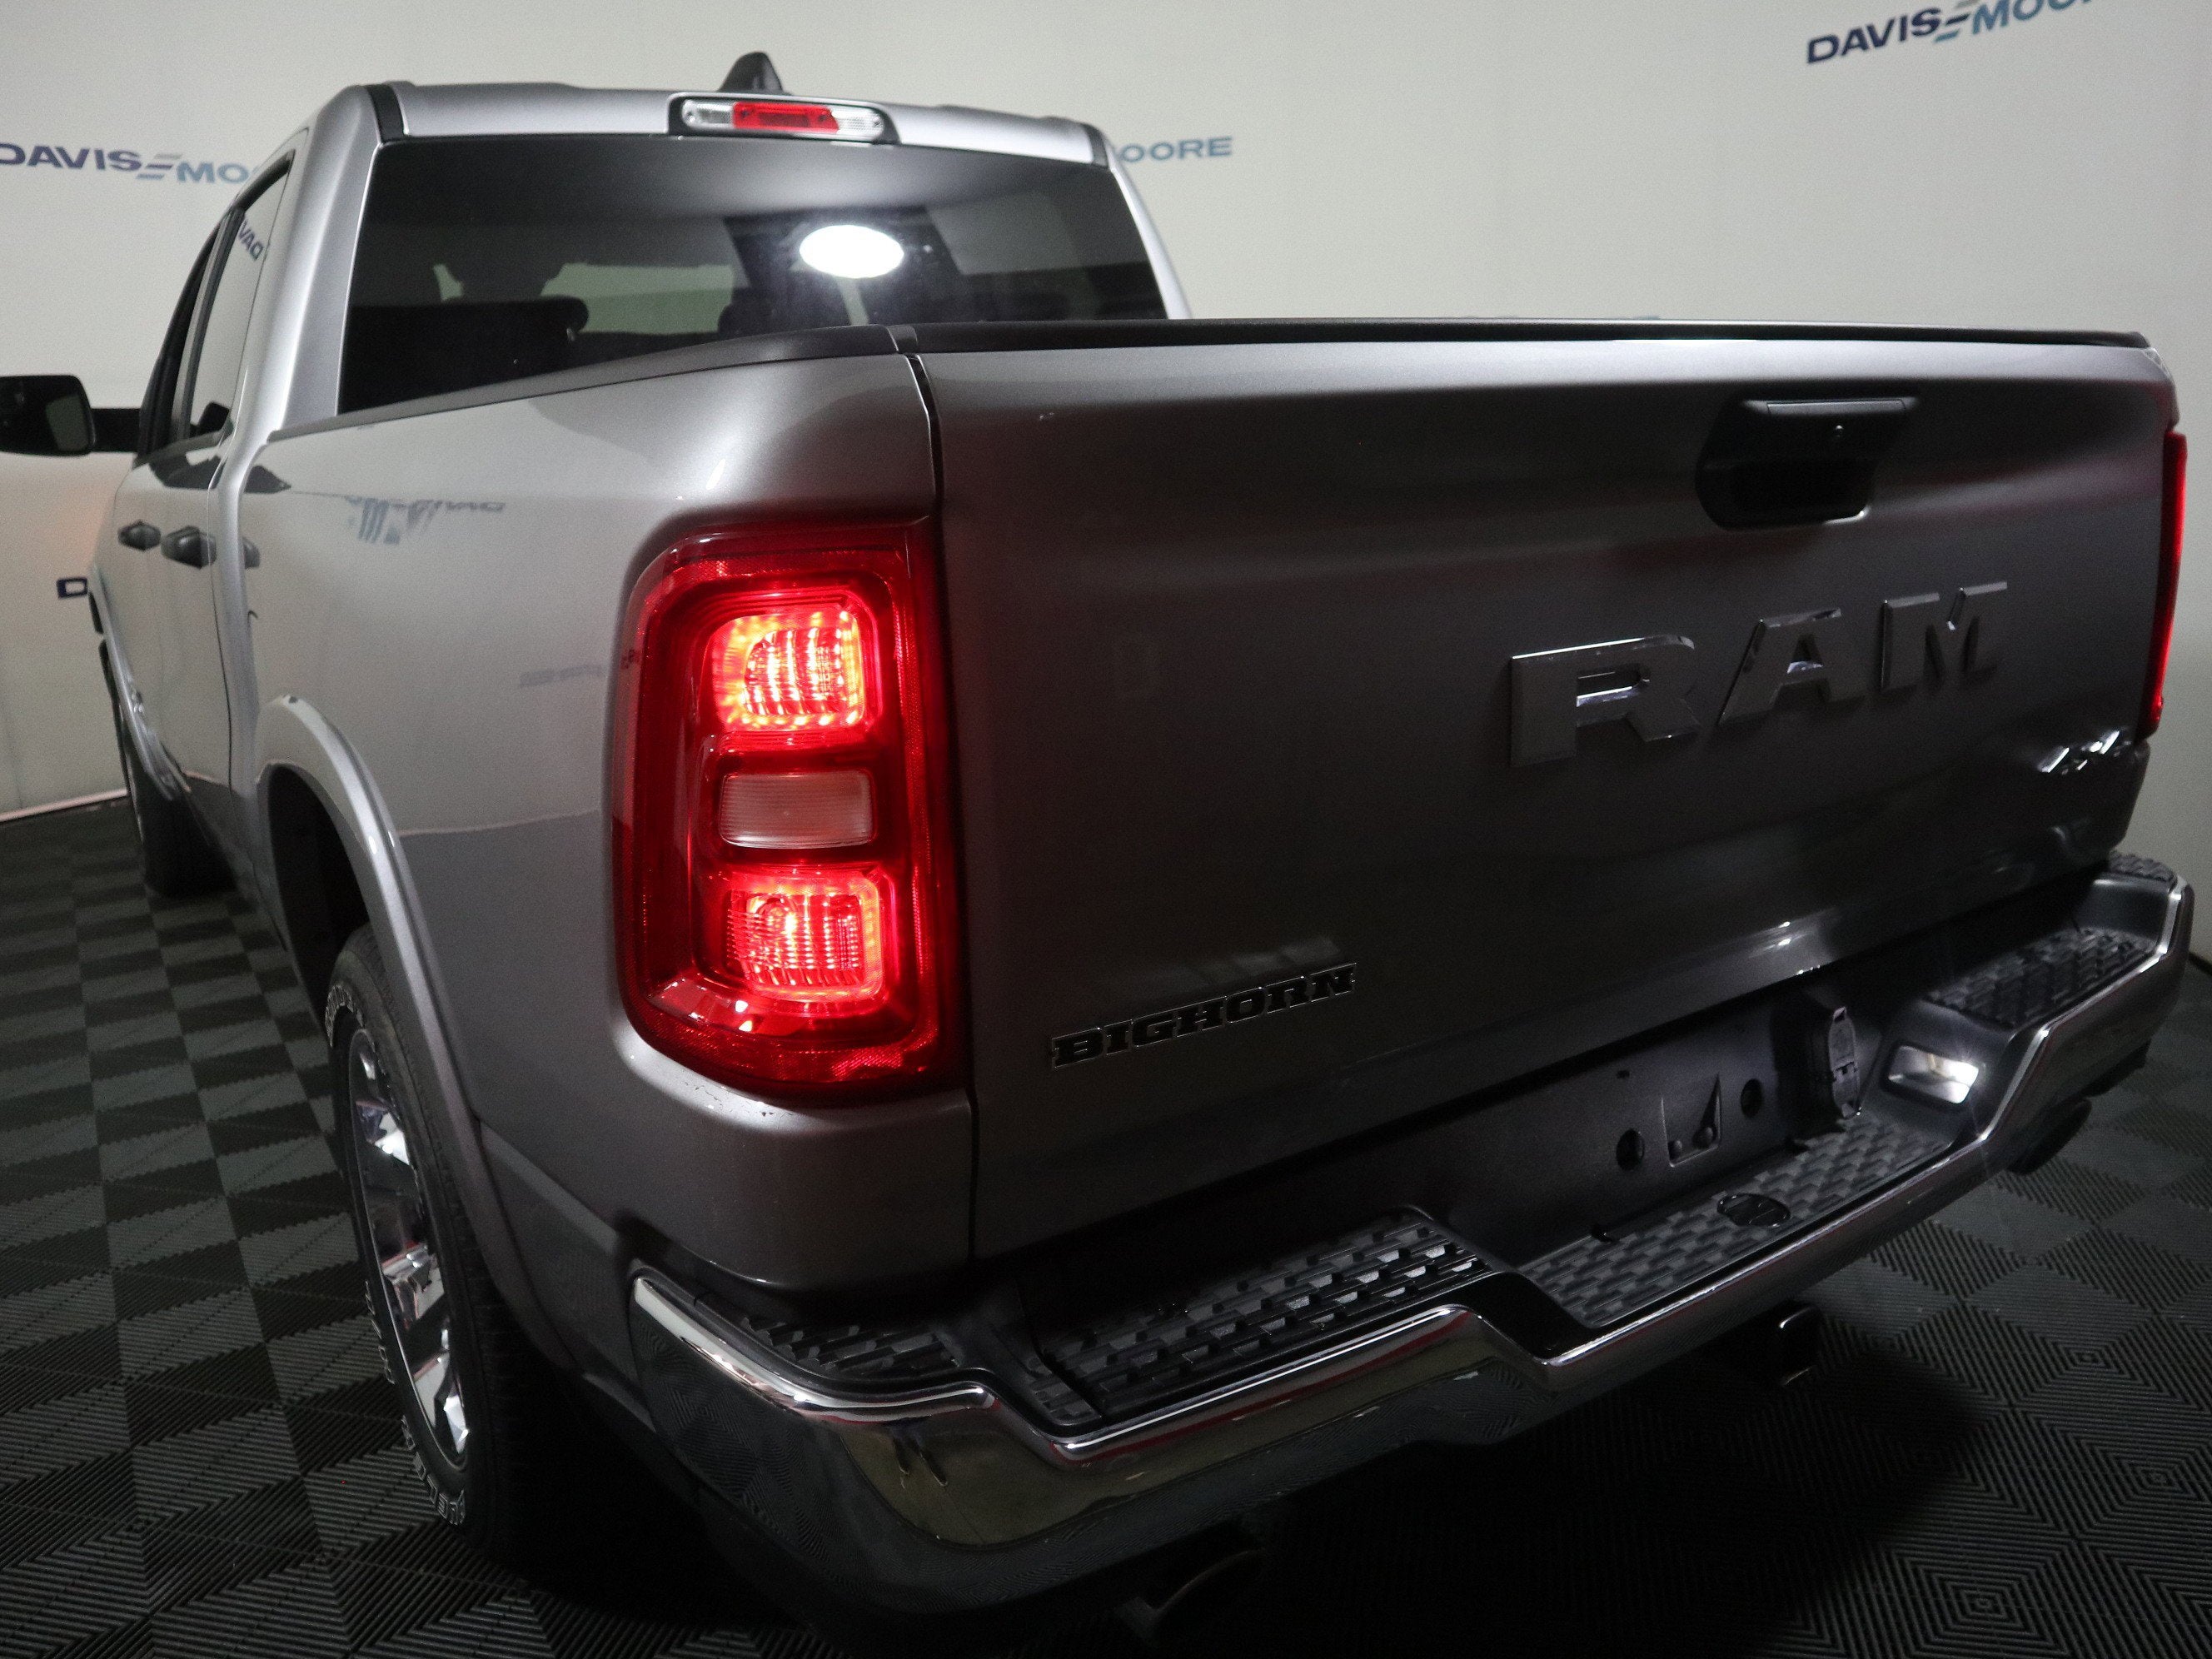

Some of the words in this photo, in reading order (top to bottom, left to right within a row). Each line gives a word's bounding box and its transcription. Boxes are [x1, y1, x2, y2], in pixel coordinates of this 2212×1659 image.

[1806, 7, 1941, 64] DAVIS
[0, 142, 142, 172] DAVIS
[1509, 580, 2009, 769] RAM
[1051, 962, 1358, 1070] BIGHORN
